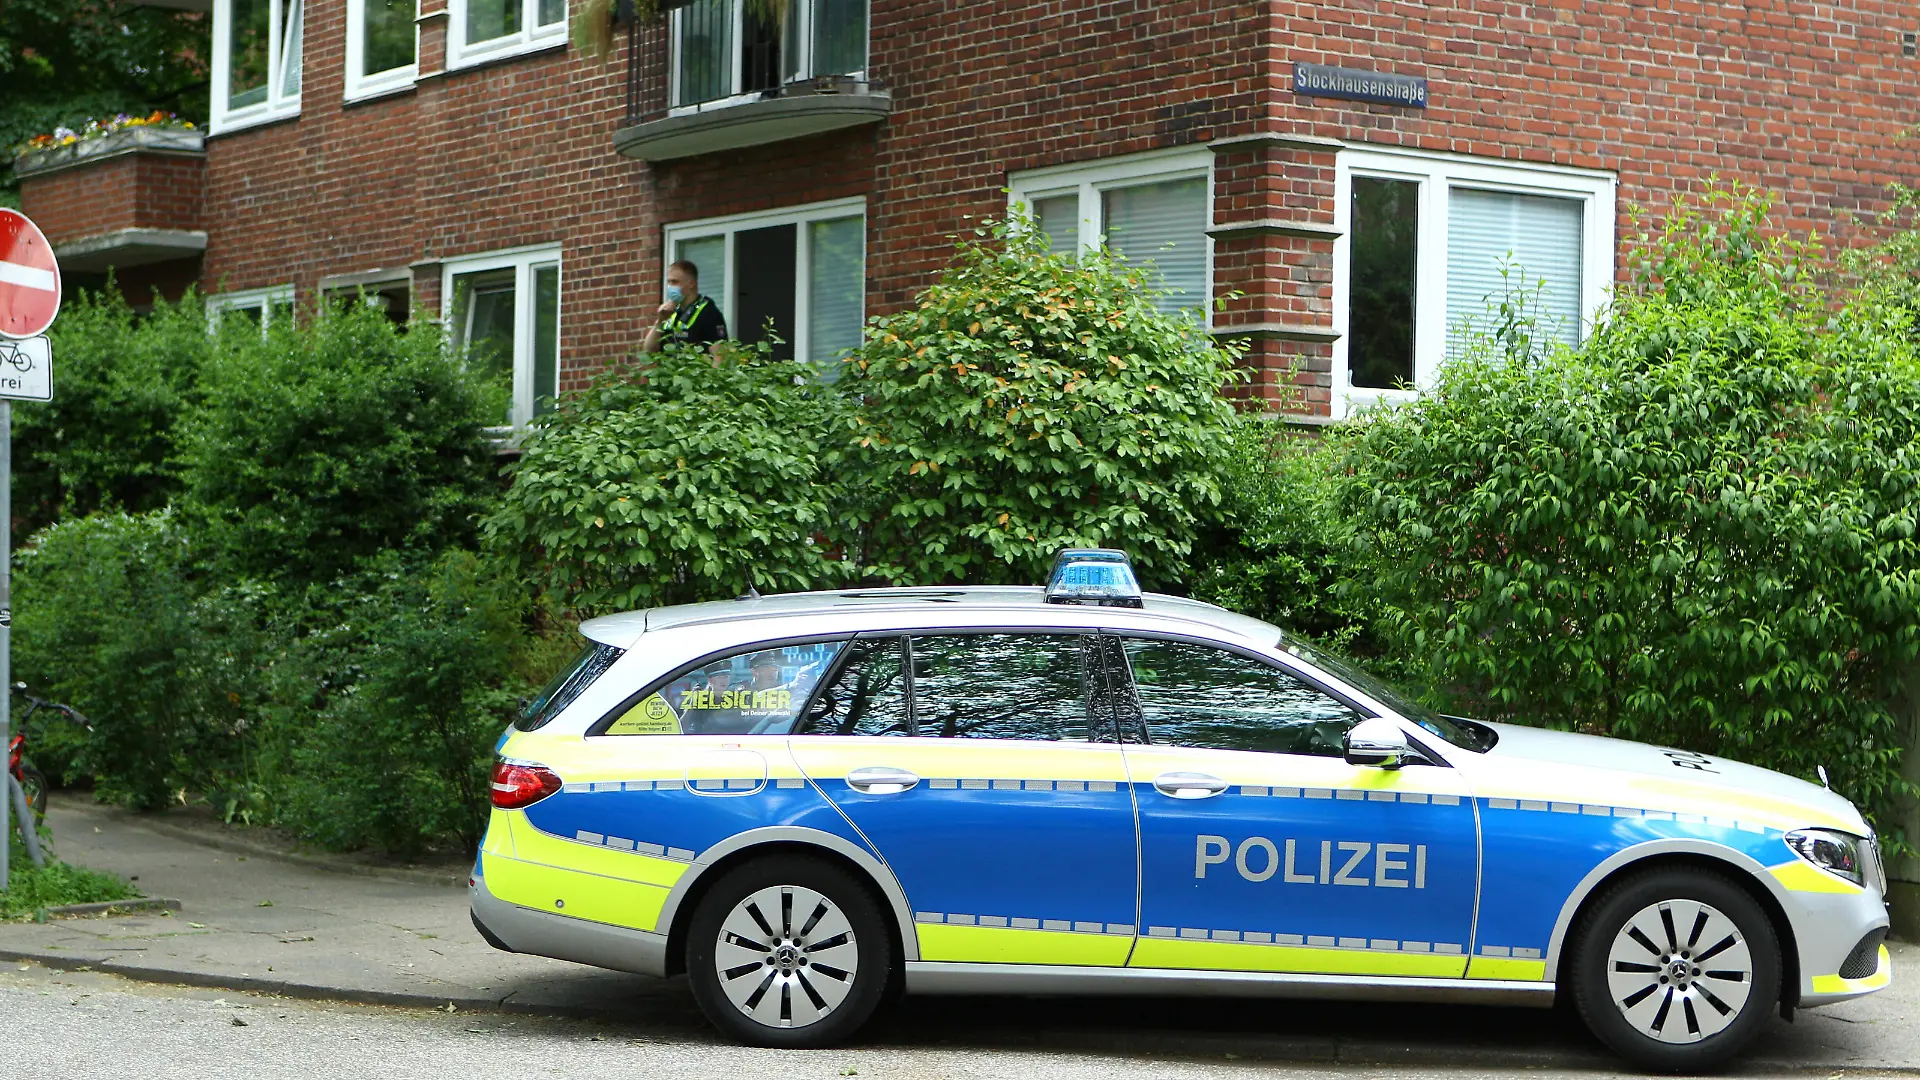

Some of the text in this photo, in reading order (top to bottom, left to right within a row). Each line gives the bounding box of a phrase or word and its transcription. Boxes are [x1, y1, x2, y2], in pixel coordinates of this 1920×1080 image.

[1297, 67, 1425, 104] Stockhausenstraße
[1, 375, 21, 389] rei
[680, 690, 791, 710] ZIELSICHER
[1195, 834, 1427, 889] POLIZEI
